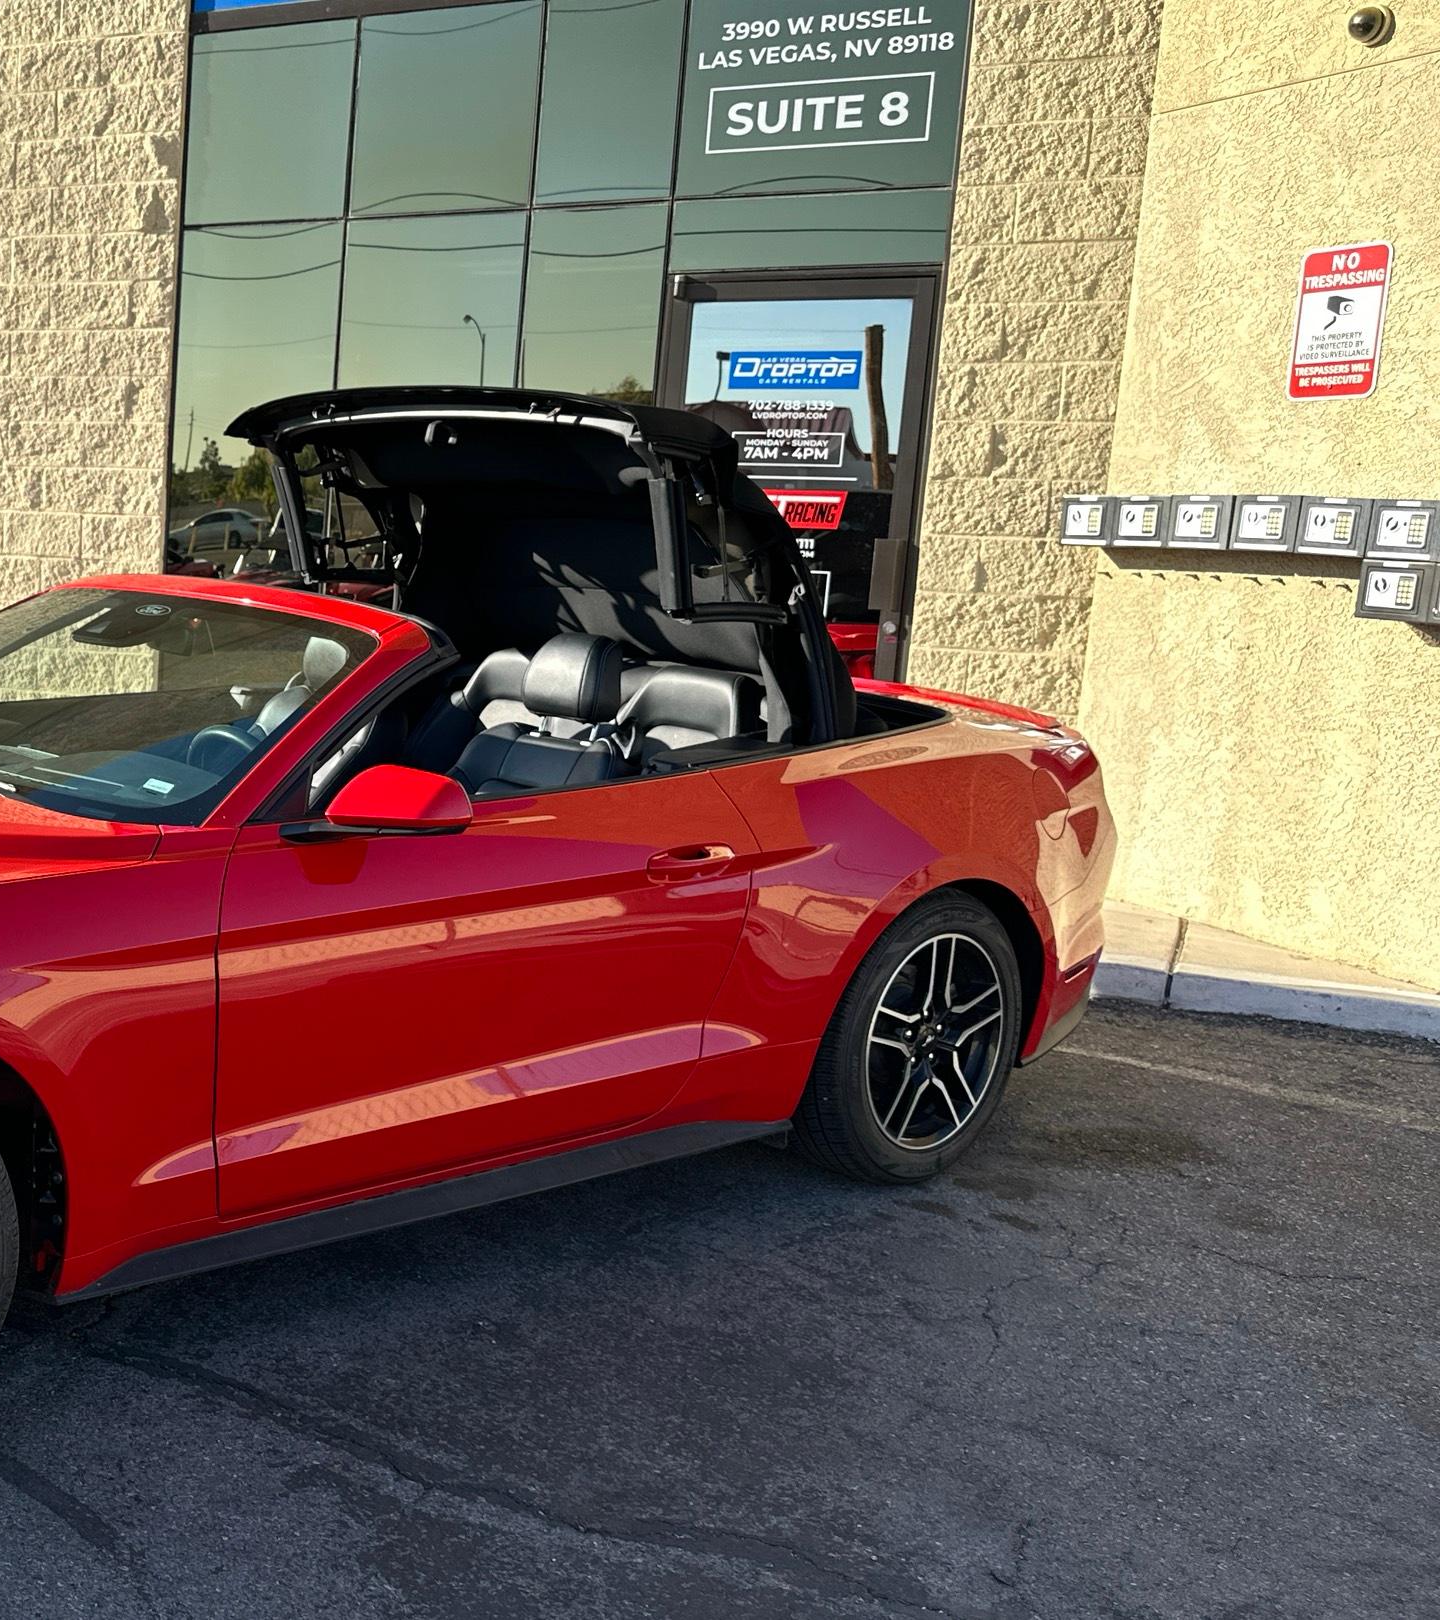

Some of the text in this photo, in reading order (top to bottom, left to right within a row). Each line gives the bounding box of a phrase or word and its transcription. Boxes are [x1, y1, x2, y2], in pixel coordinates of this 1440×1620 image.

[721, 6, 932, 42] 3990 W. RUSSELL
[698, 31, 954, 70] LAS VEGAS, NV 89118
[726, 91, 909, 136] SUITE 8
[1332, 252, 1360, 271] NO
[1305, 268, 1385, 289] TRESPASSING
[1311, 331, 1363, 342] THIS PROPERTY
[1315, 341, 1354, 350] PROTECTED
[1355, 340, 1364, 348] BY
[1299, 349, 1369, 361] VIDEO SURVEILLANCE
[1295, 363, 1371, 377] TRESPASSERS WILL
[1298, 374, 1364, 387] BE PROSECUTED
[748, 399, 834, 411] 702-788-1339
[752, 411, 828, 420] LVDROPTOP.COM
[766, 429, 809, 438] HOURS
[745, 439, 785, 447] MONDAY
[792, 440, 829, 448] SUNDAY
[743, 446, 779, 459] 7AM
[791, 448, 829, 460] 4PM
[784, 502, 838, 523] RACING
